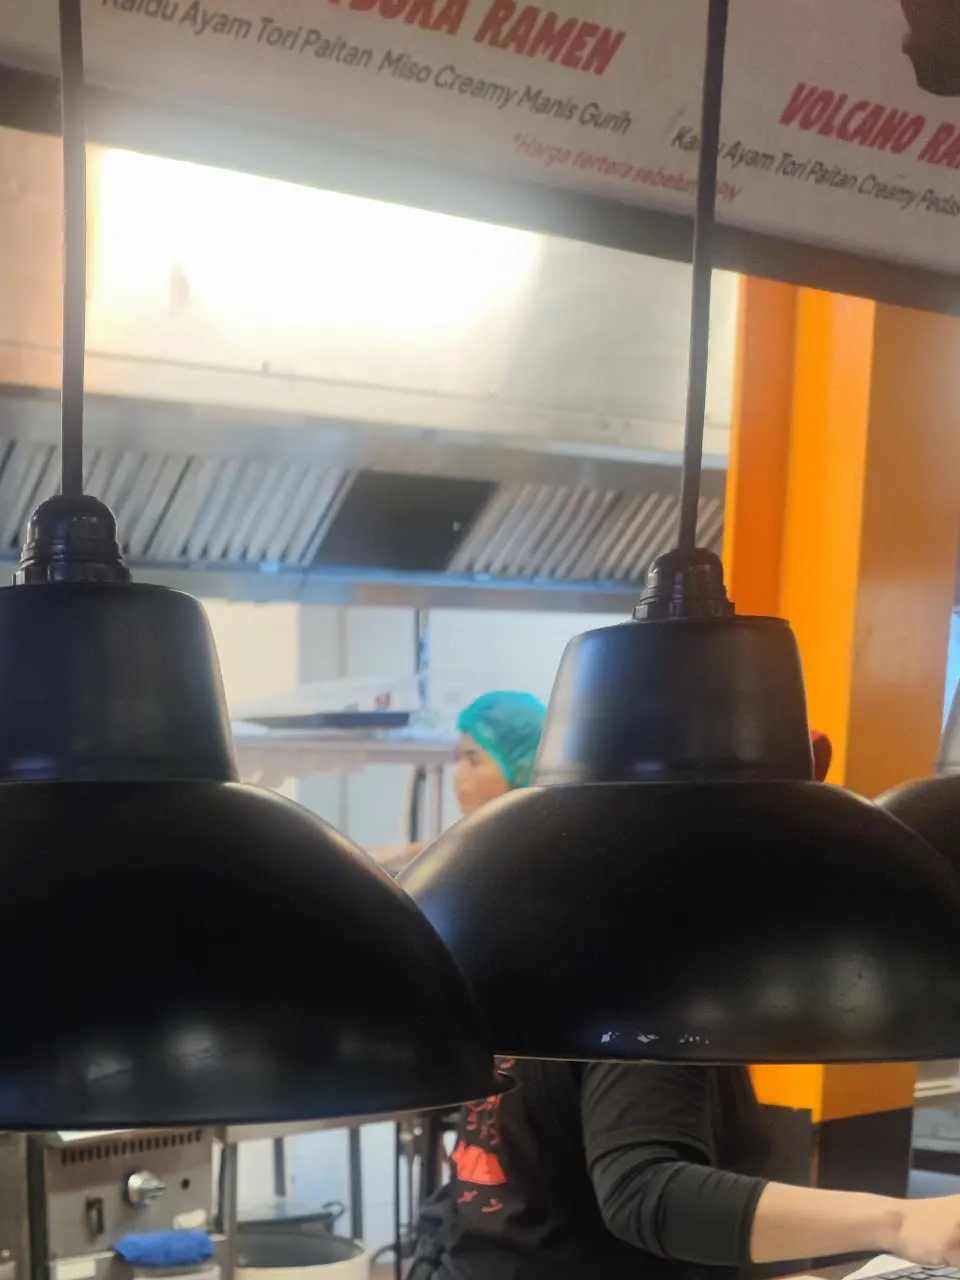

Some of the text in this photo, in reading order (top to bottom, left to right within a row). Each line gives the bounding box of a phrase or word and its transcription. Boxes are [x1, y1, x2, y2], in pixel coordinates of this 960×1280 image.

[179, 4, 253, 39] Ayam
[256, 16, 303, 51] Tori
[299, 28, 373, 69] Paitan
[378, 50, 431, 84] Miso
[434, 64, 518, 109] Creamy
[517, 85, 579, 121] Manis
[473, 0, 626, 76] RAMEN
[778, 82, 927, 154] VOLCANO
[722, 141, 775, 171] Ayam
[775, 152, 811, 181] Tori
[806, 160, 858, 190] Paitan
[858, 174, 917, 211] Creamy
